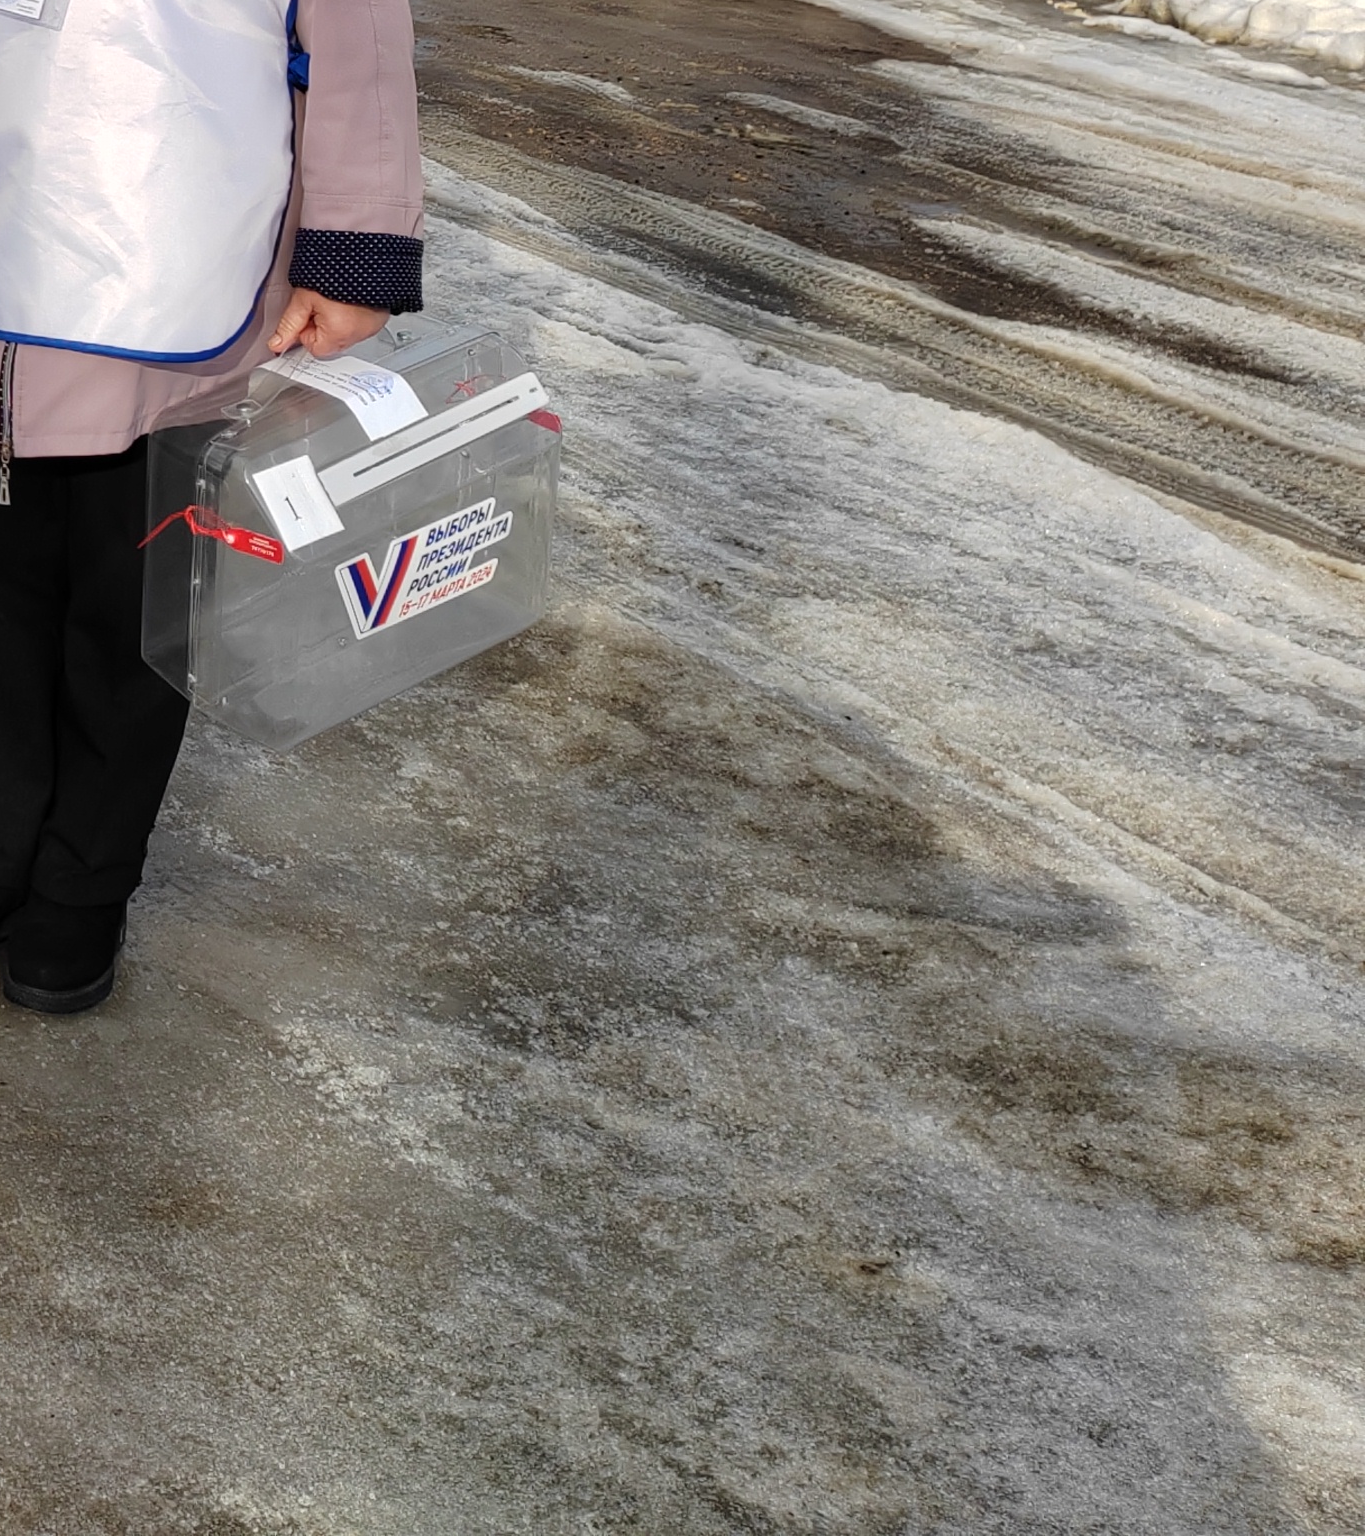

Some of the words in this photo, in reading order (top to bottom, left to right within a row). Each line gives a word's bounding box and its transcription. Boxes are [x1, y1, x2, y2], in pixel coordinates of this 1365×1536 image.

[416, 516, 510, 573] ПРЕЗИДЕНТА
[425, 502, 492, 548] ВЫБОРЫ
[406, 555, 469, 598] РОССИИ
[429, 576, 466, 606] МАРТА
